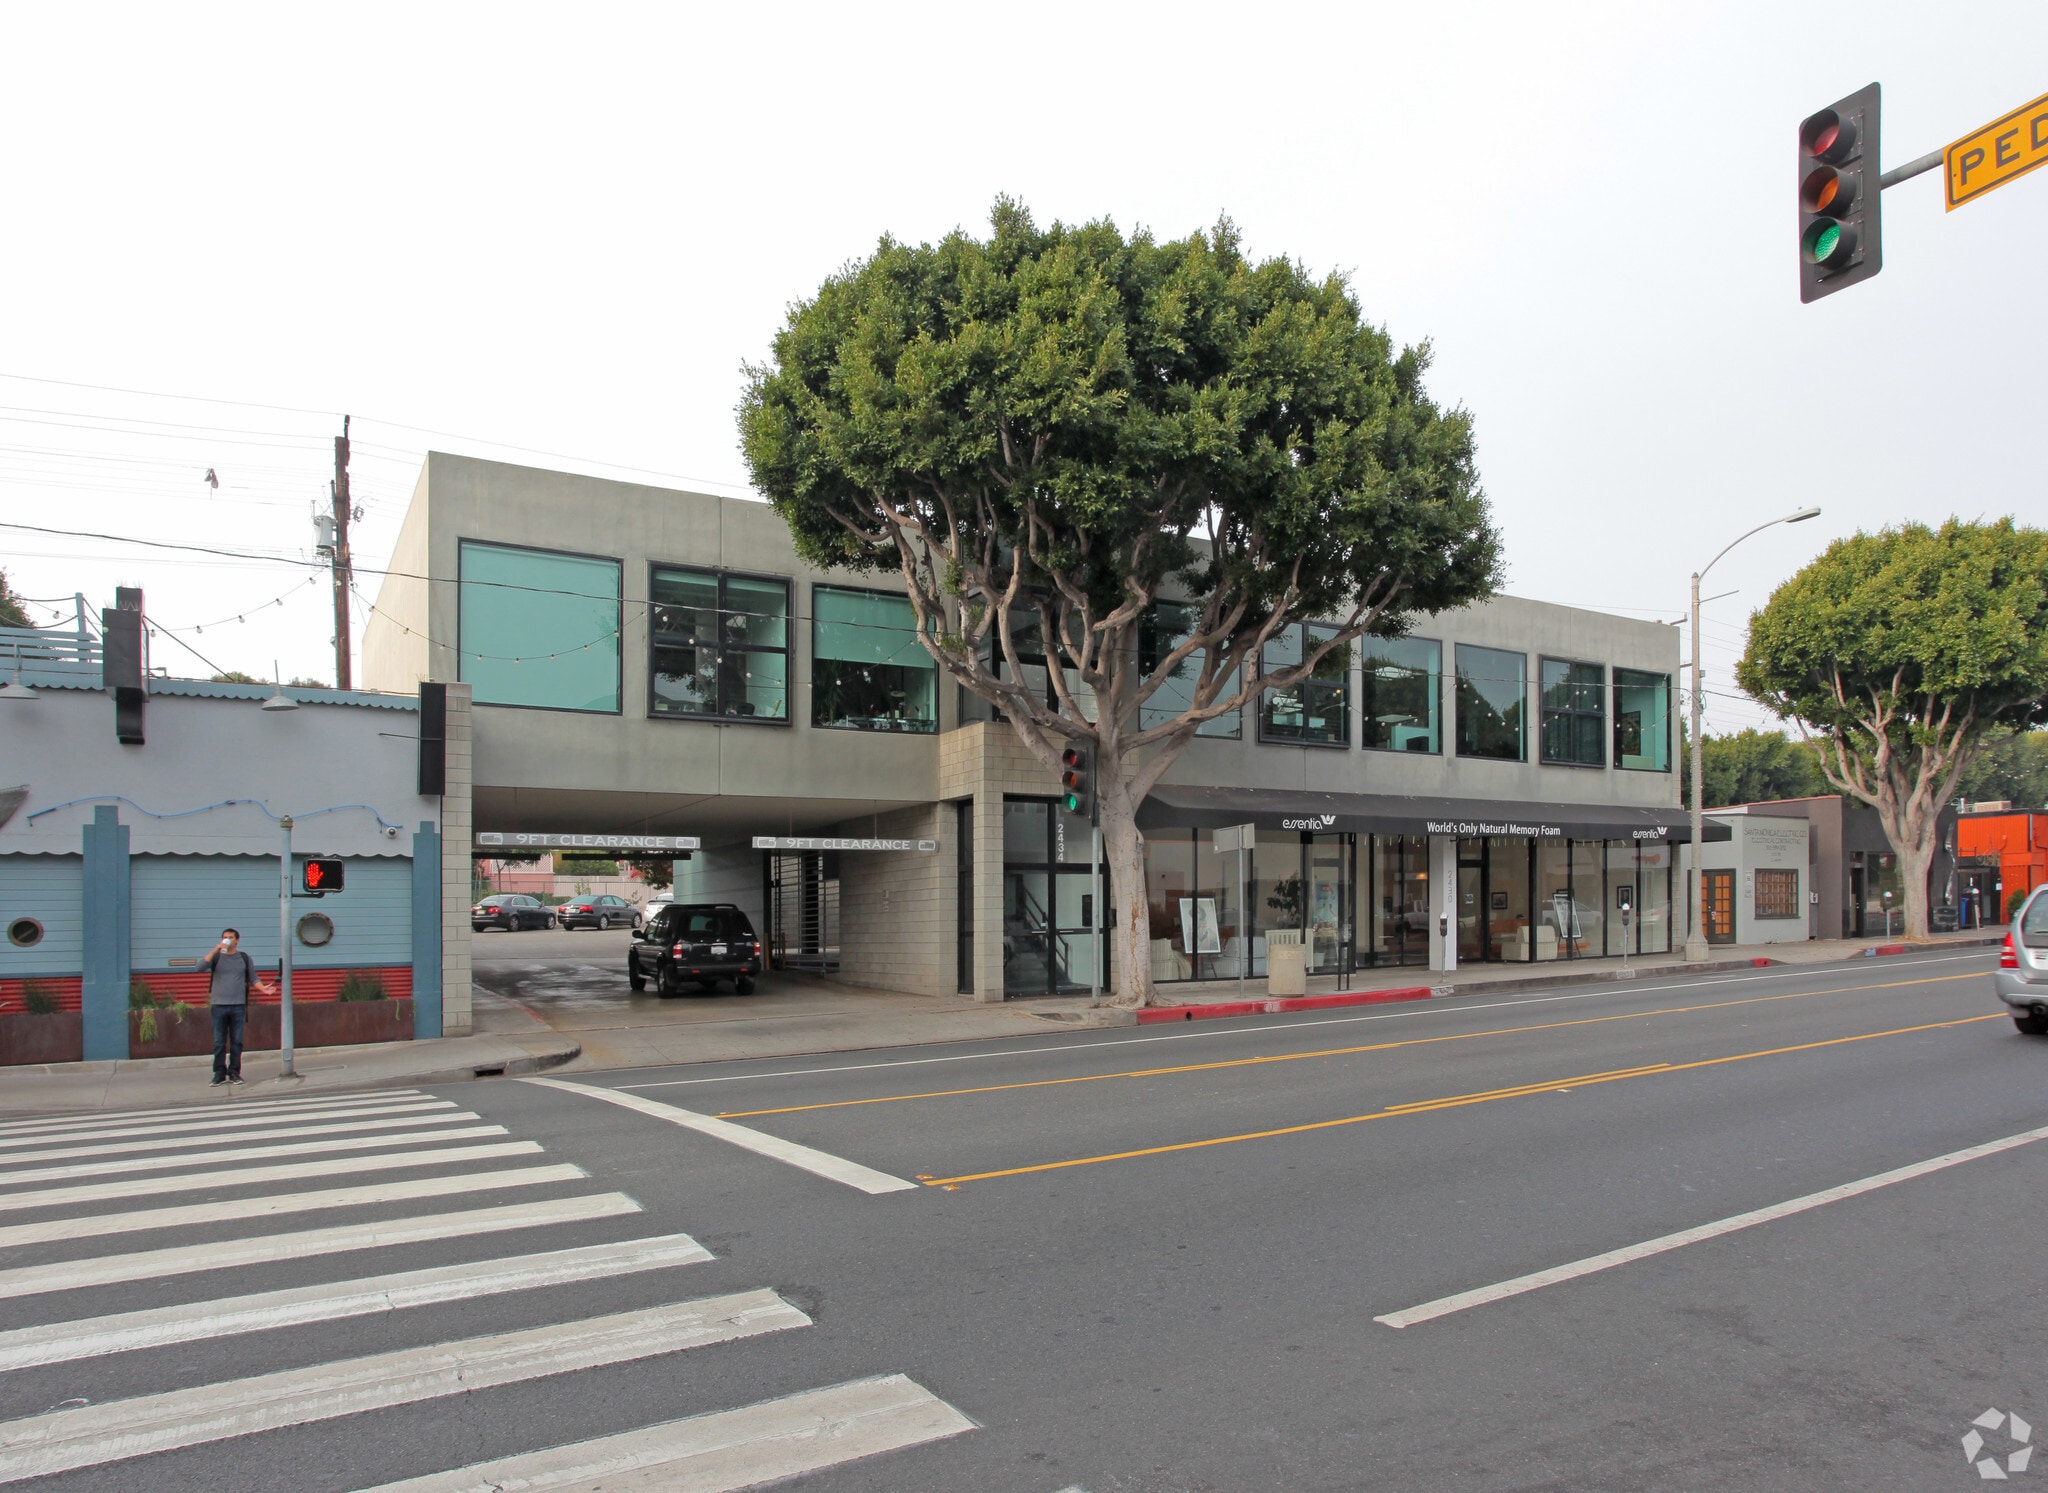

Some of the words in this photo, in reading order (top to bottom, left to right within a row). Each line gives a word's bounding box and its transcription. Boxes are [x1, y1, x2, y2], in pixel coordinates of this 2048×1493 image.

[1282, 817, 1323, 830] essentia
[1427, 822, 1458, 833] World's
[1459, 822, 1478, 836] Only
[1480, 823, 1508, 834] Natural
[1509, 825, 1540, 837] Memory
[1541, 825, 1561, 836] Foam
[515, 834, 550, 845] 9FT
[559, 834, 667, 847] CLEARANCE
[786, 838, 815, 848] 9FT
[822, 838, 911, 850] CLEARANCE
[1057, 823, 1065, 863] 2434
